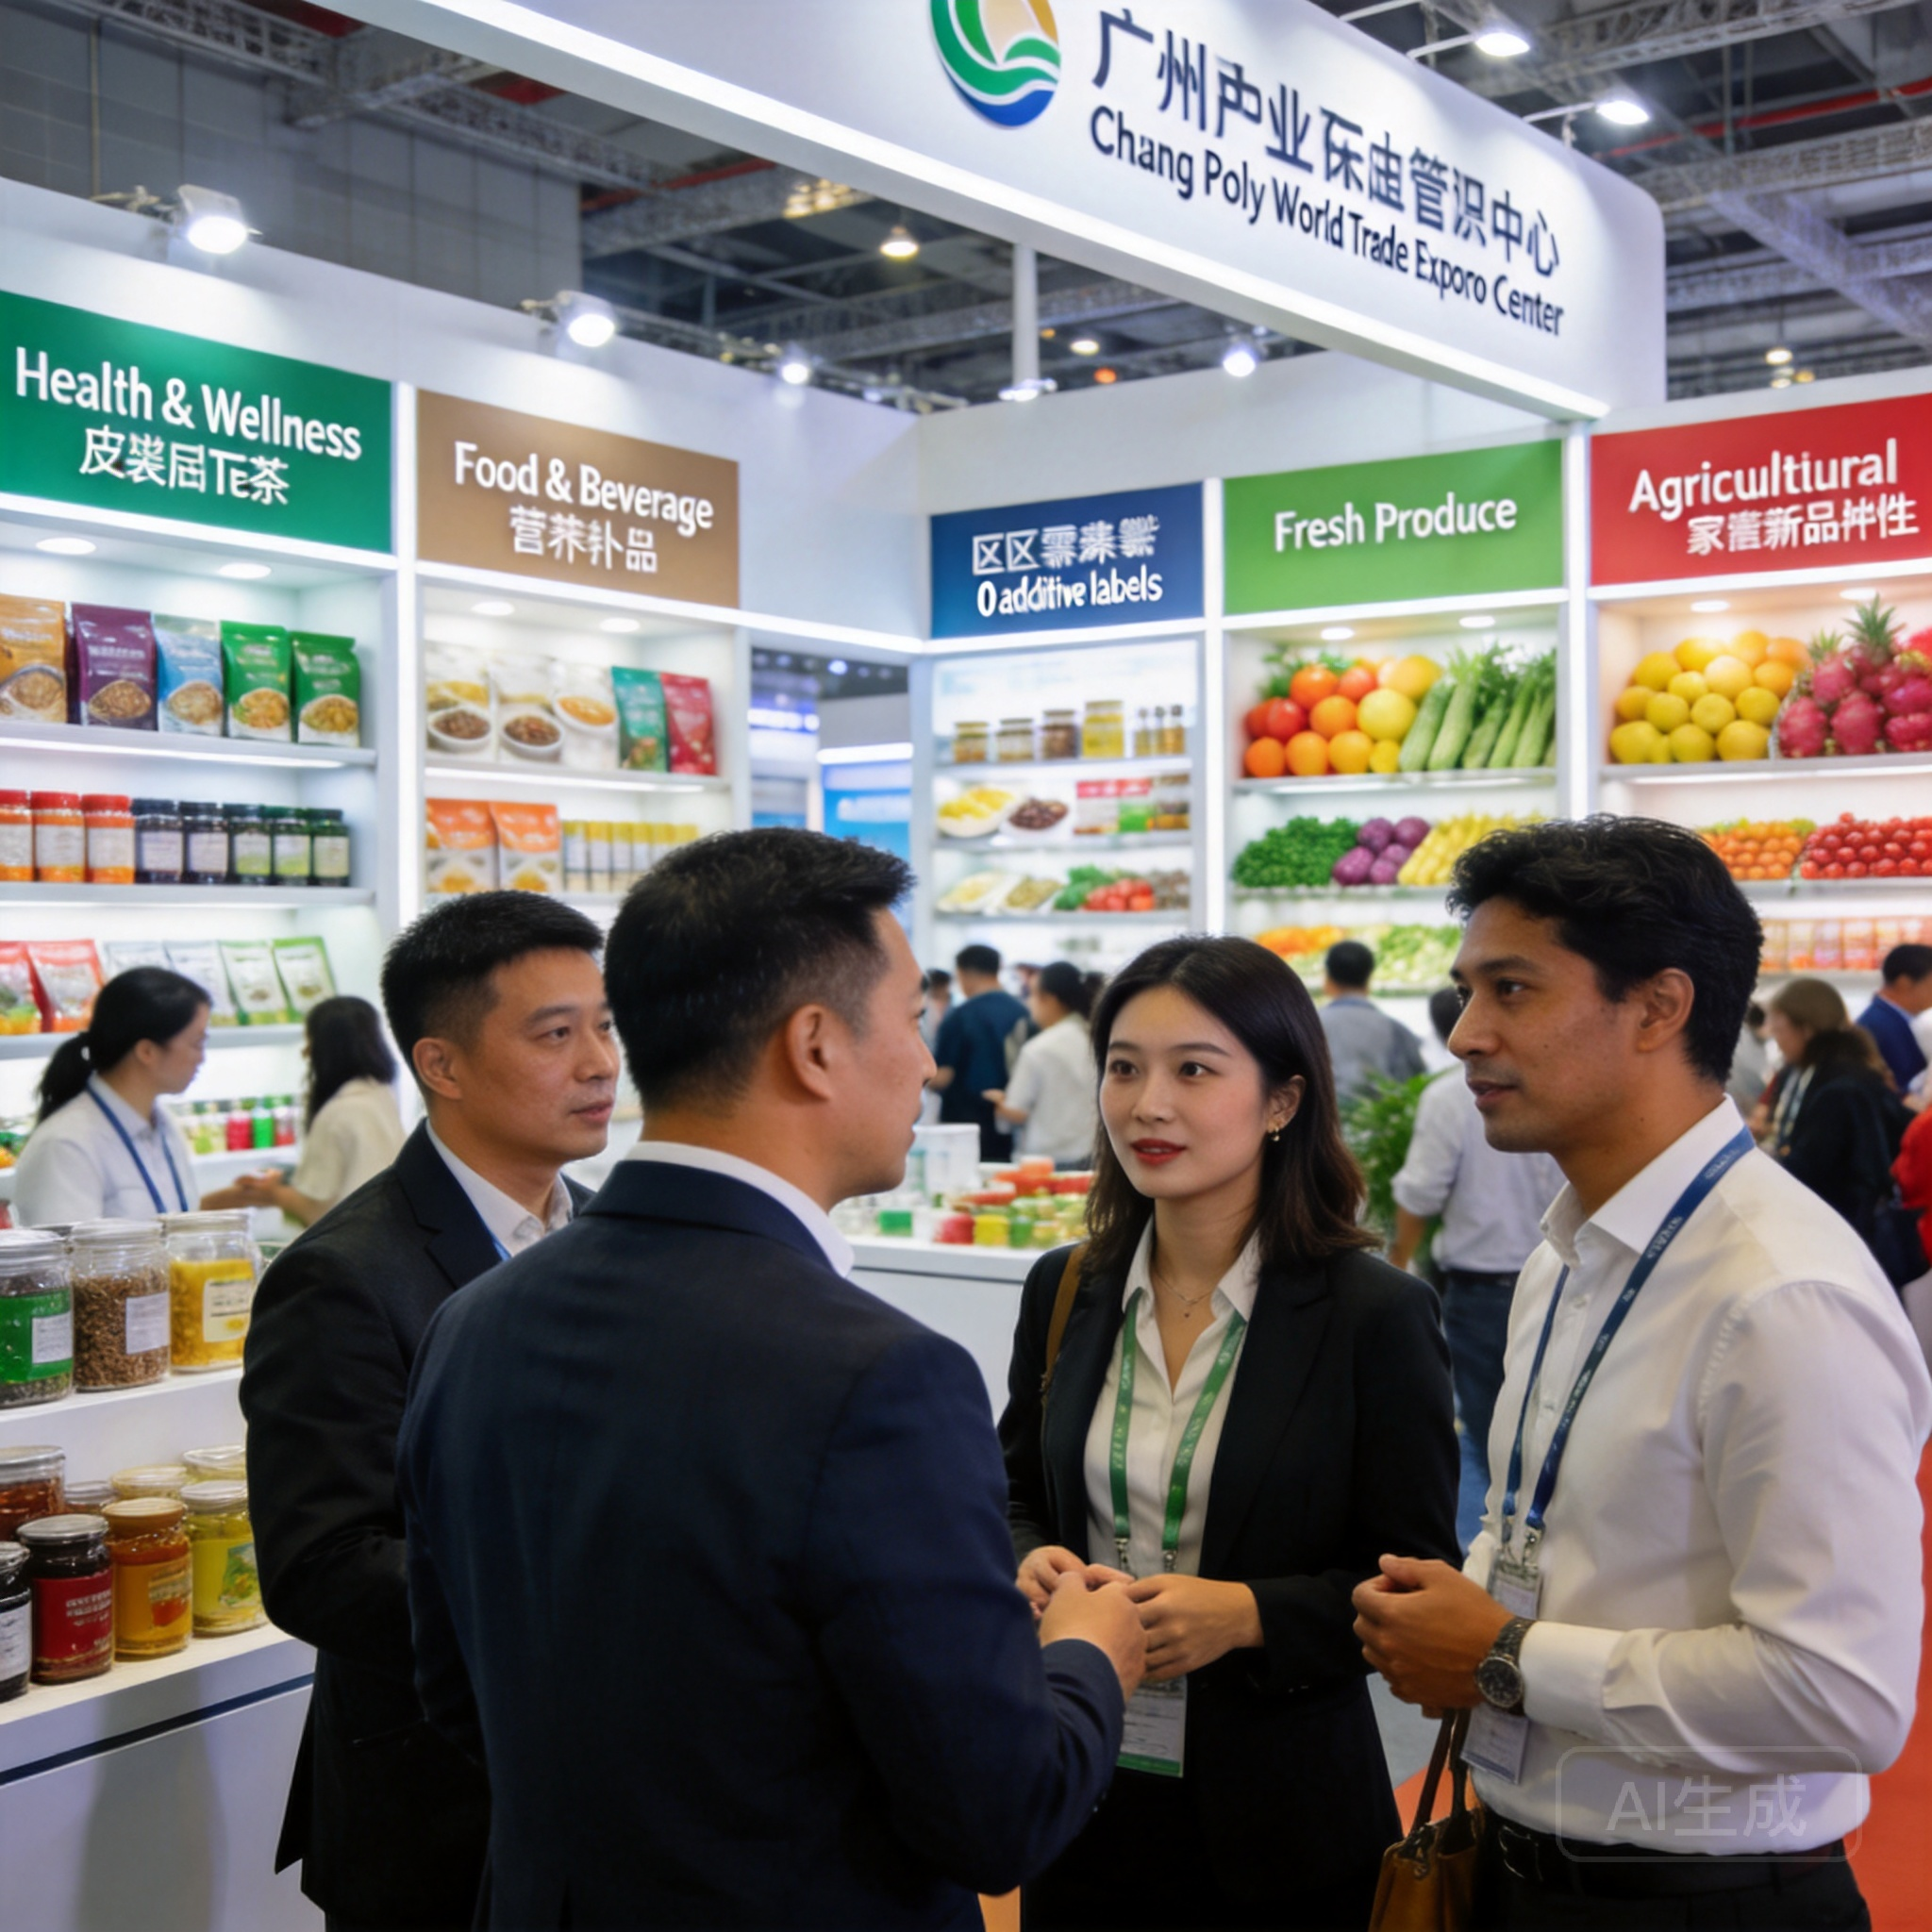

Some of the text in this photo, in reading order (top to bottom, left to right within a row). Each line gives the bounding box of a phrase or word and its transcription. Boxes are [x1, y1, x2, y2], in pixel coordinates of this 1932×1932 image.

[1091, 105, 1193, 200] Chang
[1205, 149, 1265, 225] Poly
[1273, 176, 1343, 250] World
[1348, 210, 1408, 273] Trade
[1493, 275, 1564, 336] Center
[16, 346, 362, 461] Health & Wellness
[454, 441, 714, 538] Food & Beverage
[1274, 491, 1518, 553] Fresh Produce
[1091, 564, 1163, 605] labels
